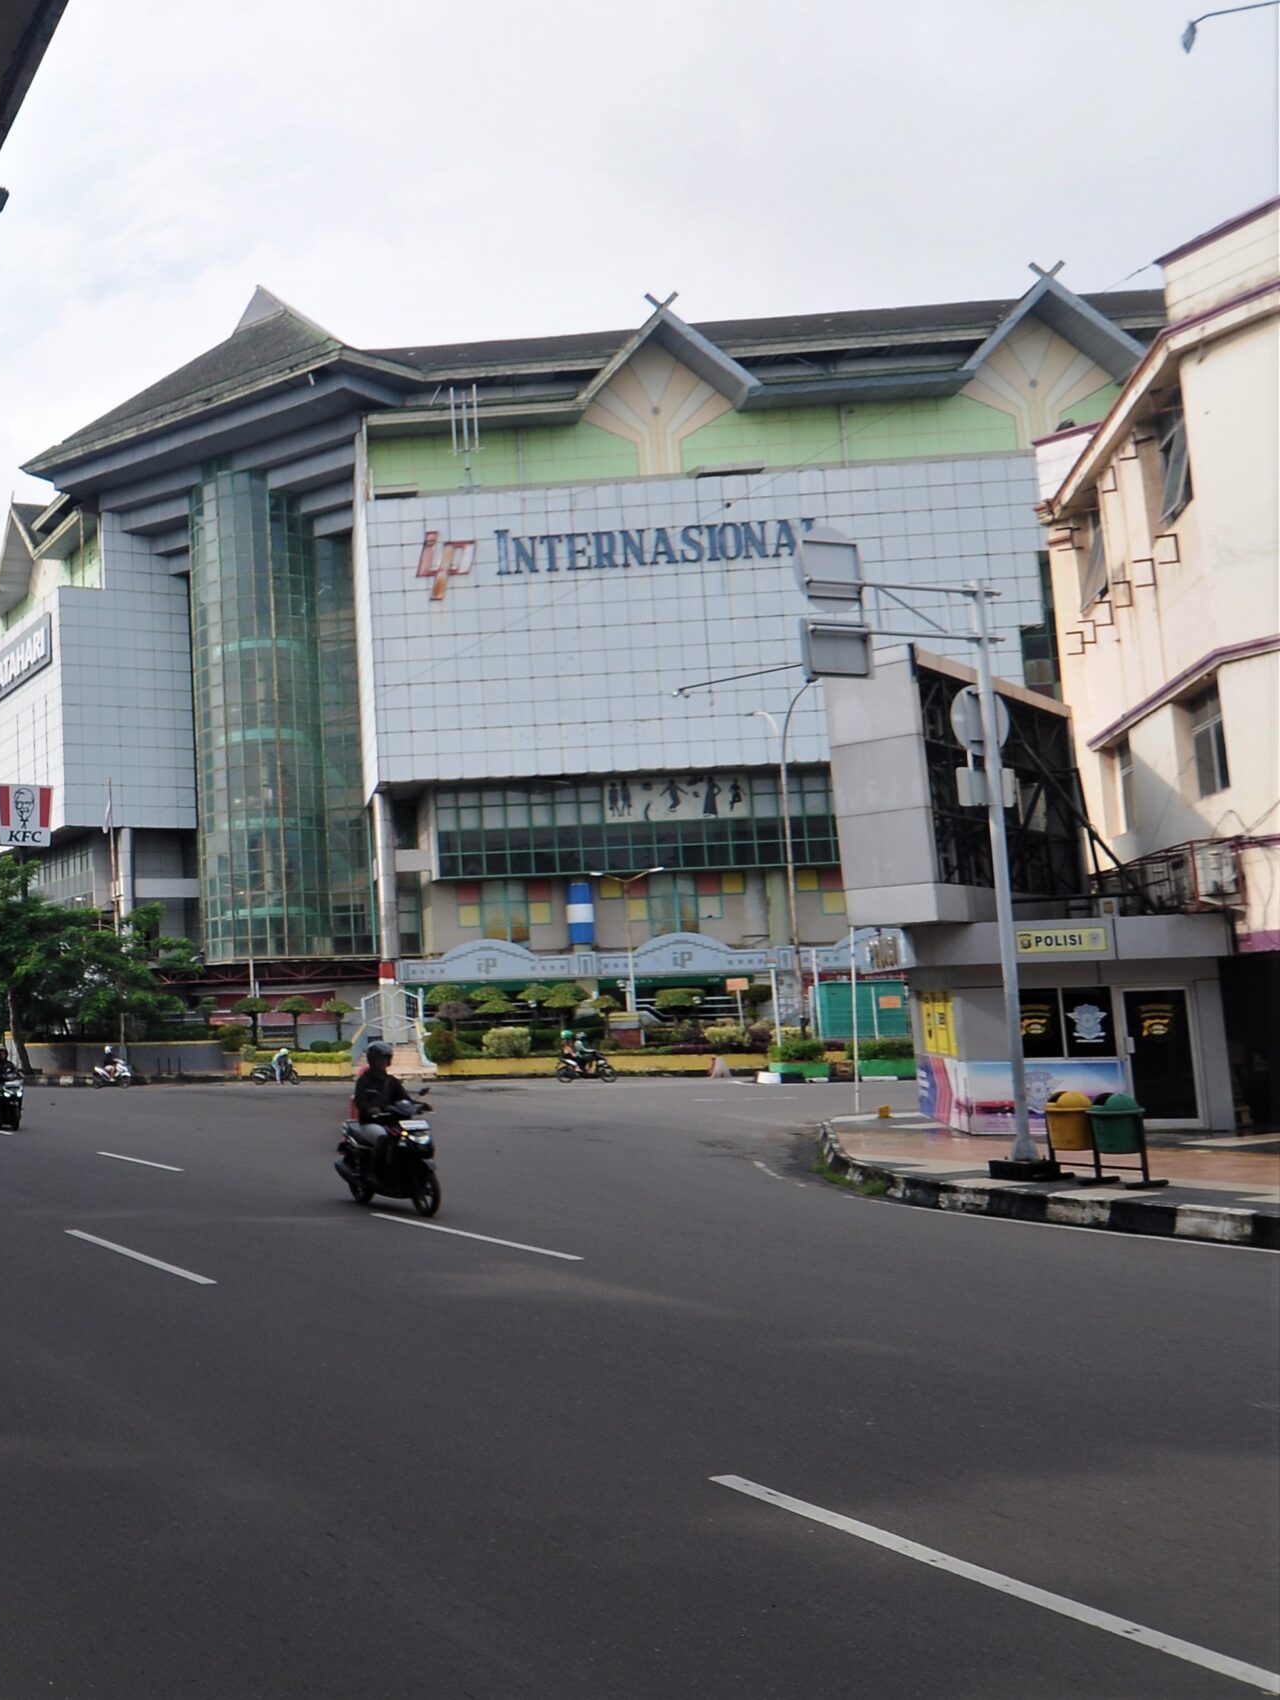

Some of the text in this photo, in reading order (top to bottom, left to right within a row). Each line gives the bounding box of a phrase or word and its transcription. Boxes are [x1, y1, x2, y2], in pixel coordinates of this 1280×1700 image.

[494, 517, 816, 576] INTERNASIONA
[7, 830, 42, 843] KFC
[1034, 934, 1083, 947] POLISI
